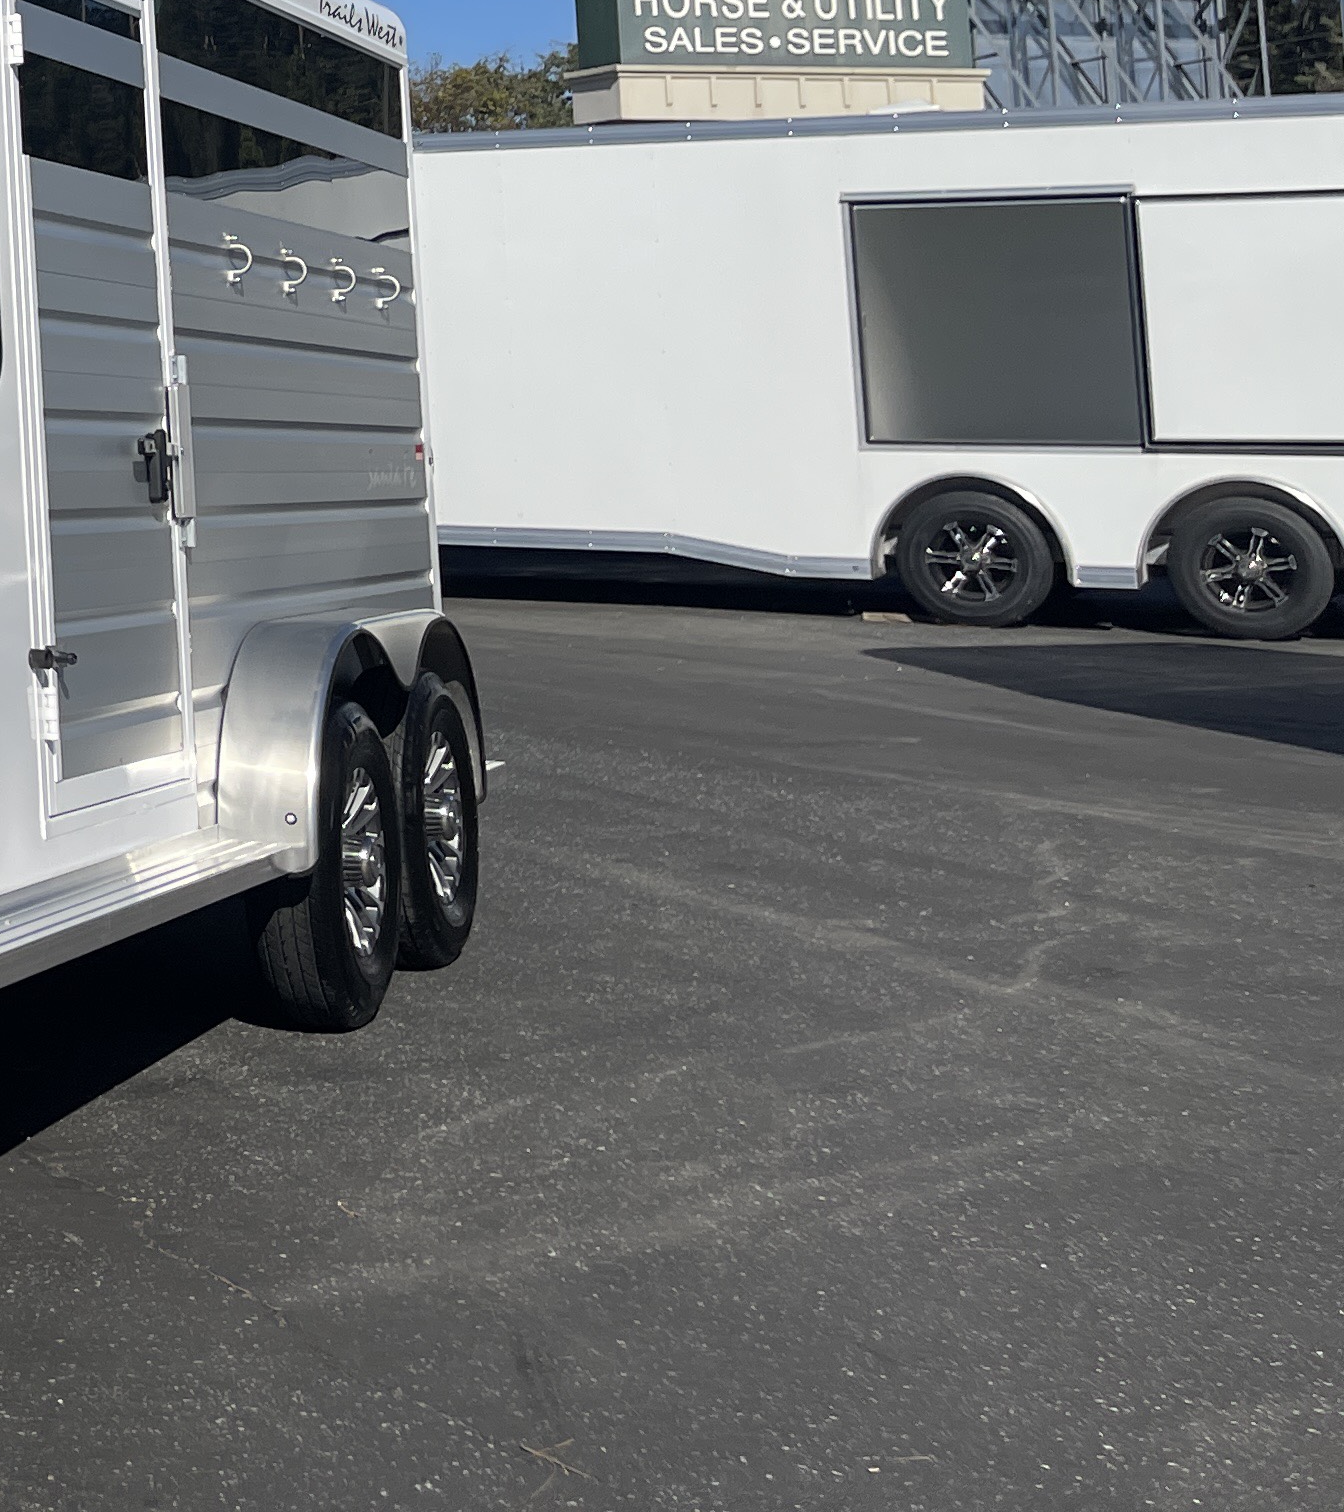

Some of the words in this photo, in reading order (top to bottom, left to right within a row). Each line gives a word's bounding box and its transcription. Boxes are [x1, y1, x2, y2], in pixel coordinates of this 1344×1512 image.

[364, 6, 397, 48] West
[643, 26, 764, 55] SALES
[786, 29, 950, 58] SERVICE
